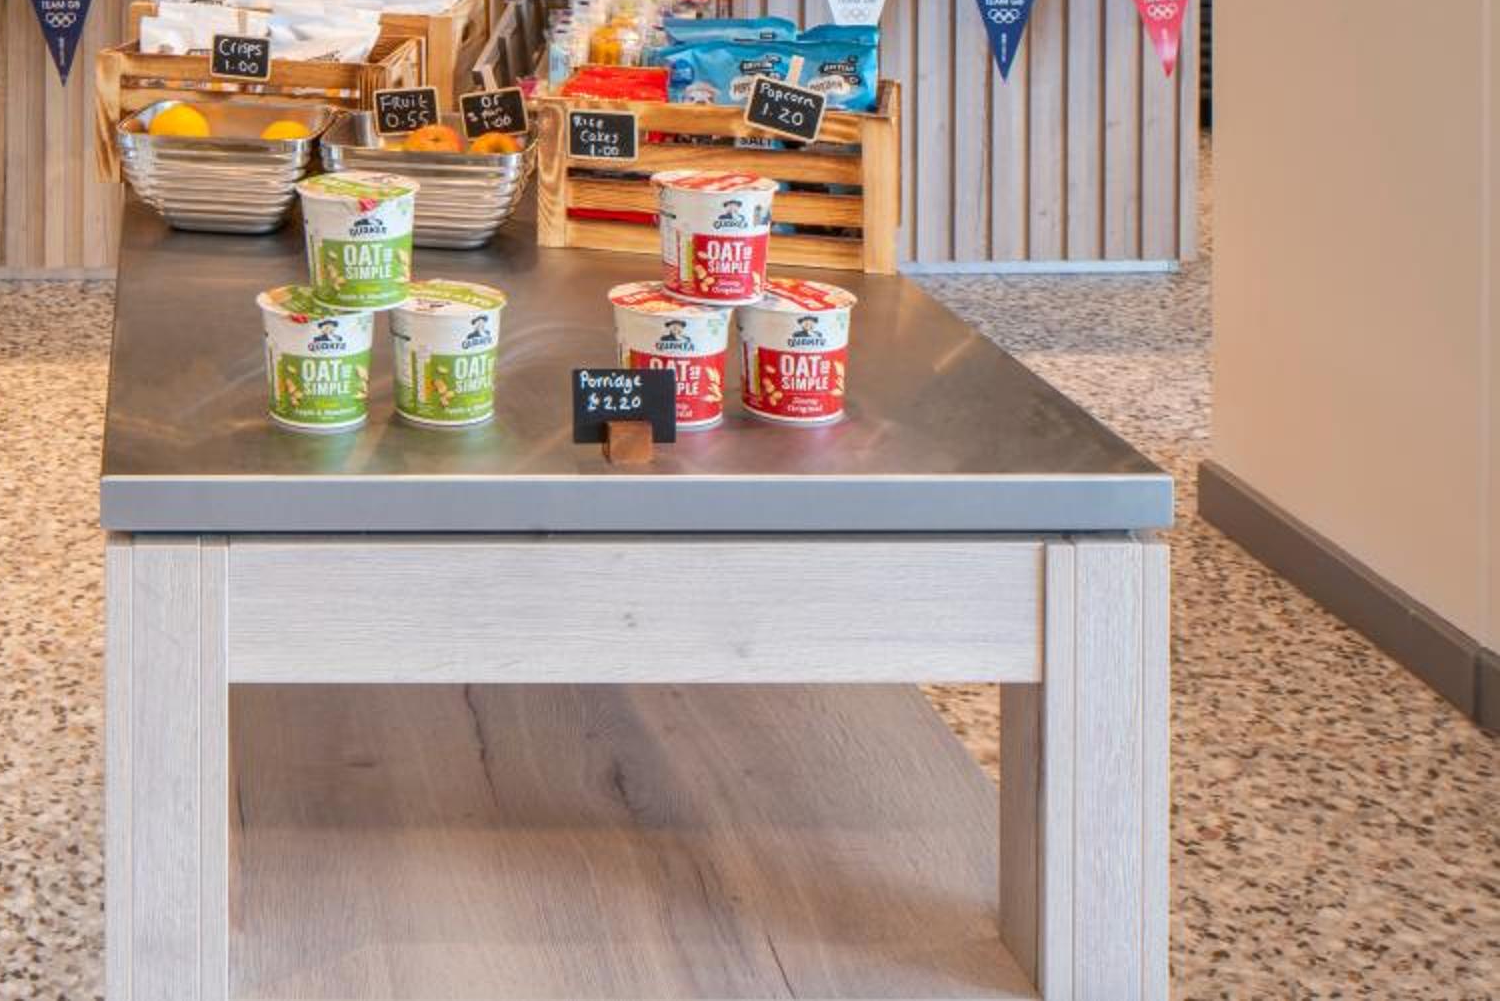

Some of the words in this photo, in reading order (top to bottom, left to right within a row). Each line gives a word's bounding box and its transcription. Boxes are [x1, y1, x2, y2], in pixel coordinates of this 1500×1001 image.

[41, 0, 64, 10] TEAM
[67, 0, 81, 10] GB
[219, 38, 262, 59] Crisps
[760, 82, 816, 109] Popcorn
[386, 111, 430, 128] 0.55
[762, 102, 804, 126] 1.20
[344, 244, 383, 266] OAT
[708, 241, 744, 261] OAT
[344, 266, 392, 280] SIMPLE
[708, 261, 750, 273] SIMPLE
[302, 359, 341, 382] OAT
[781, 355, 821, 376] OAT
[303, 382, 351, 396] SIMPLE
[580, 370, 643, 394] Porridge
[676, 382, 700, 396] PLE
[781, 377, 828, 391] SIMPLE
